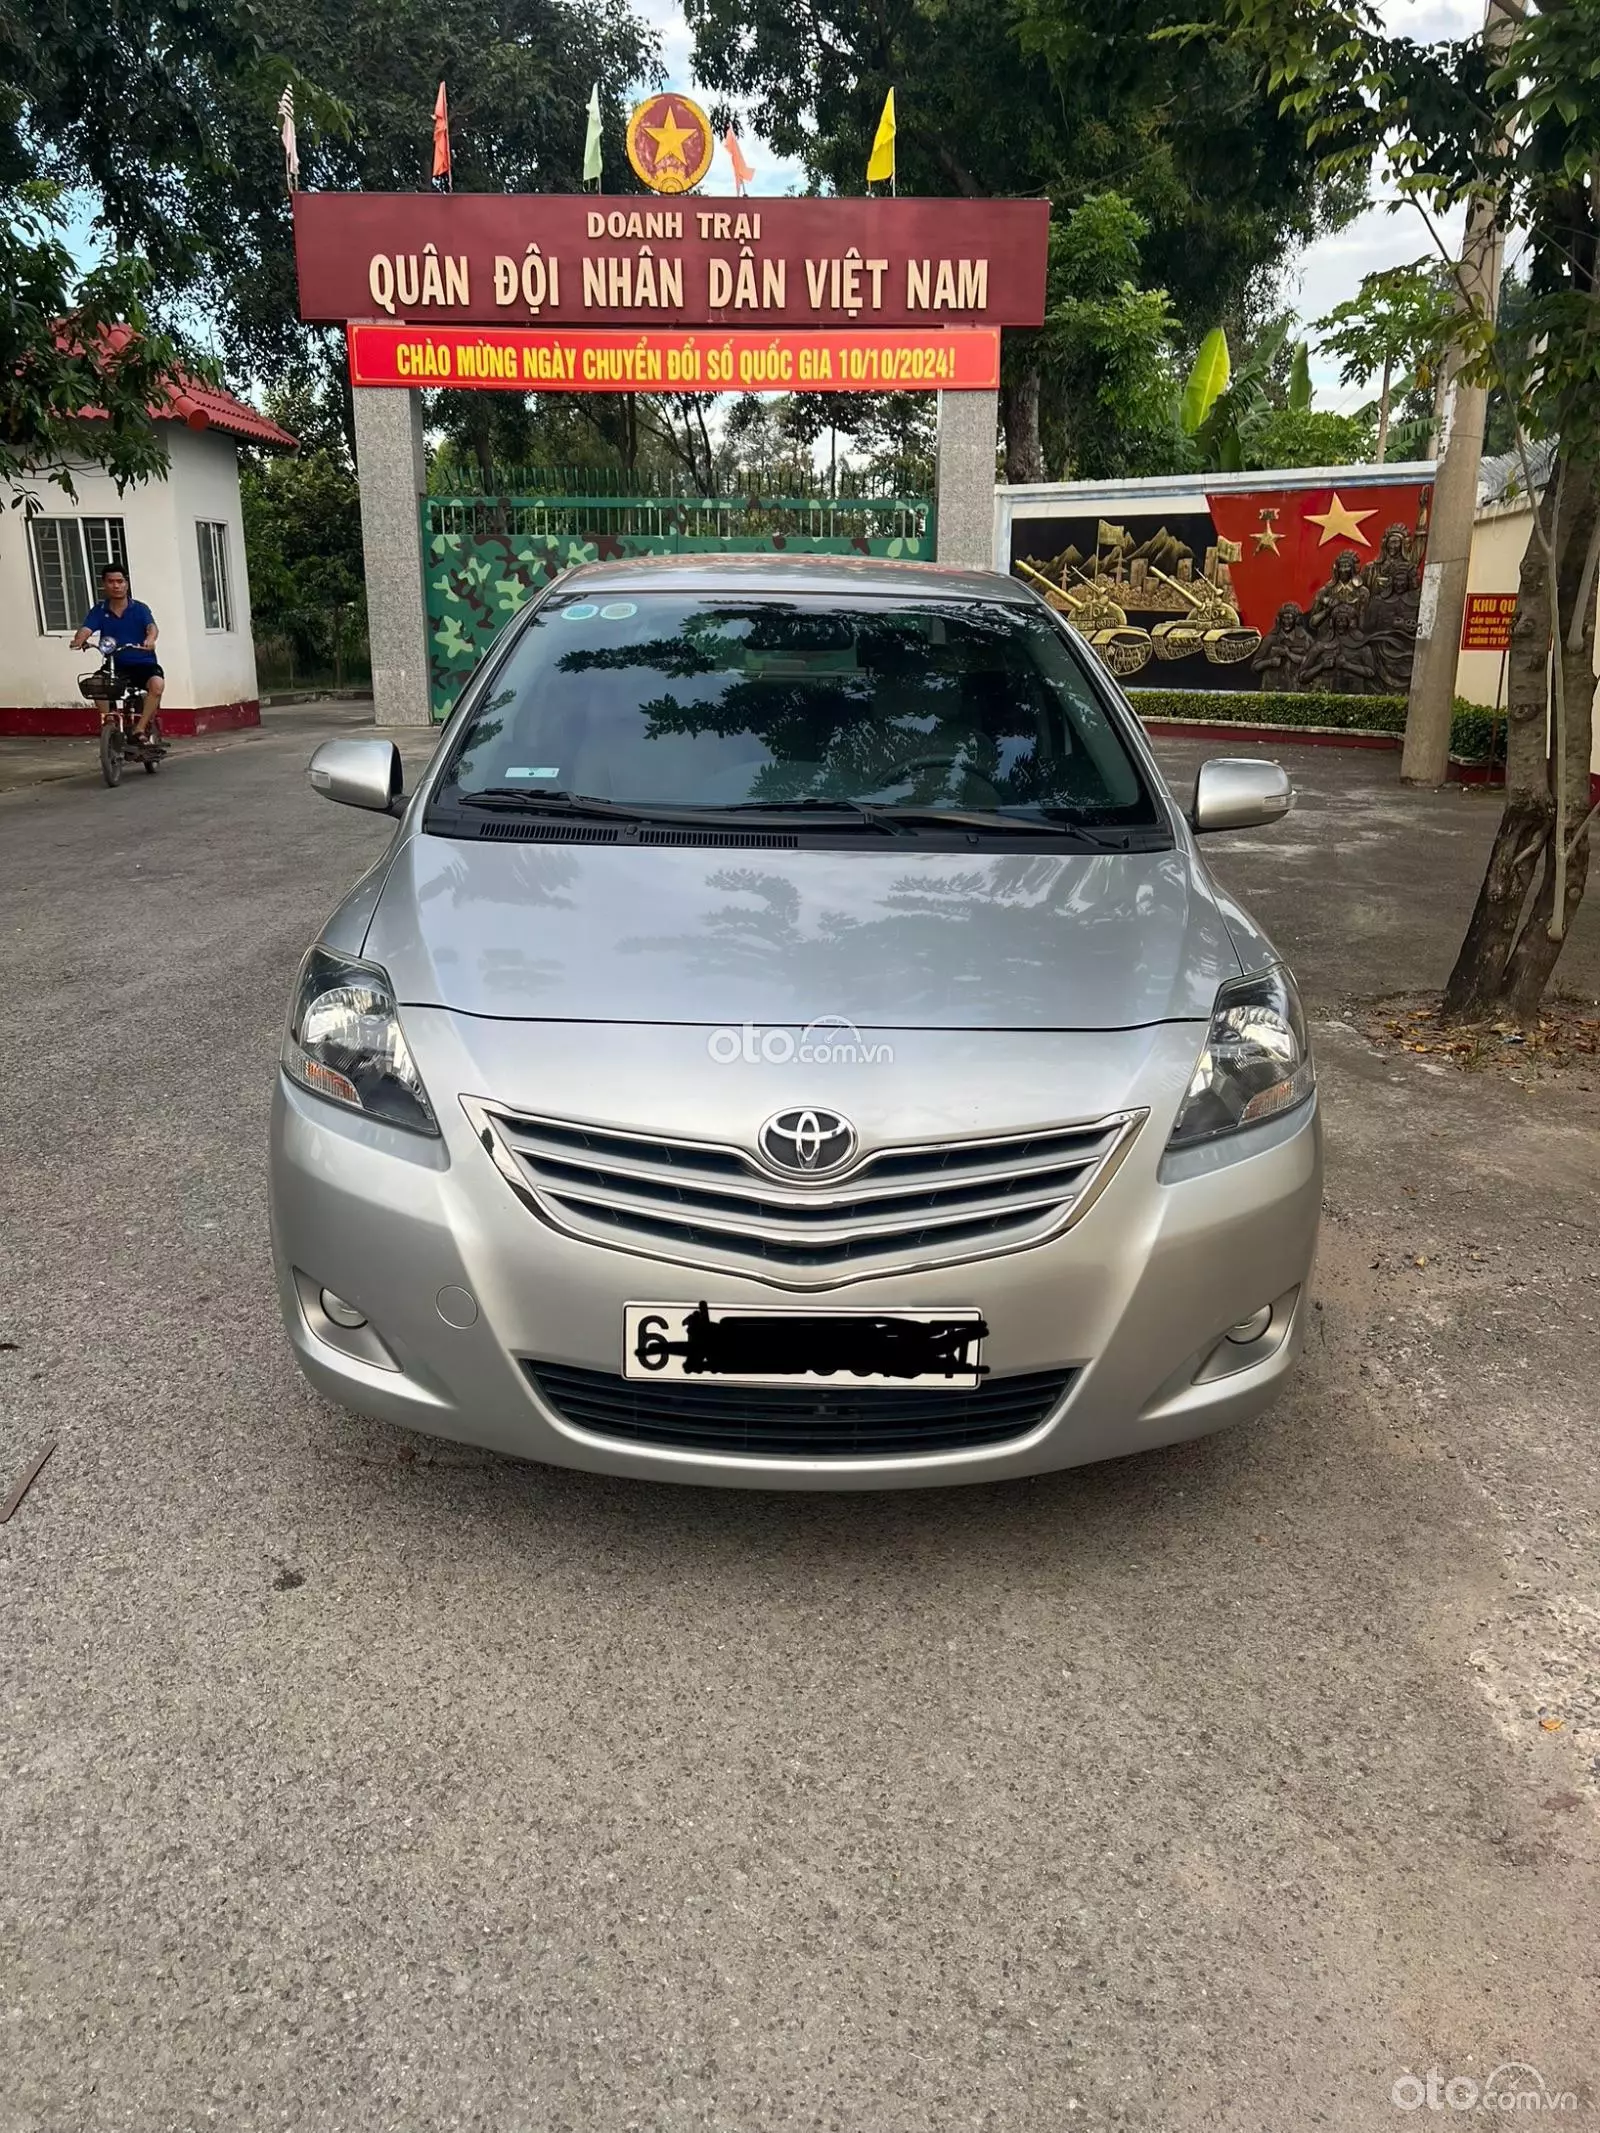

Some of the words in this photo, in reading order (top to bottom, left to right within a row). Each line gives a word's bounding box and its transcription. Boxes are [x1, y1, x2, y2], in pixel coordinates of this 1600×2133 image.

[587, 210, 683, 239] DOANH
[696, 212, 761, 245] TRẠI
[369, 242, 471, 315] QUÂN
[493, 242, 560, 315] ĐỘI
[582, 244, 684, 309] NHÂN
[708, 245, 786, 310] DÂN
[804, 246, 889, 318] VIỆT
[906, 258, 989, 310] NAM
[396, 337, 451, 377] CHÀO
[457, 338, 517, 379] MỪNG
[523, 340, 577, 380] NGÀY
[583, 336, 662, 381] CHUYỂN
[667, 336, 701, 381] ĐỔI
[707, 337, 734, 381] SỐ
[740, 337, 793, 385] QUỐC
[798, 347, 833, 380] GIA
[838, 347, 956, 380] 10/10/2024!
[1472, 598, 1497, 613] KHU
